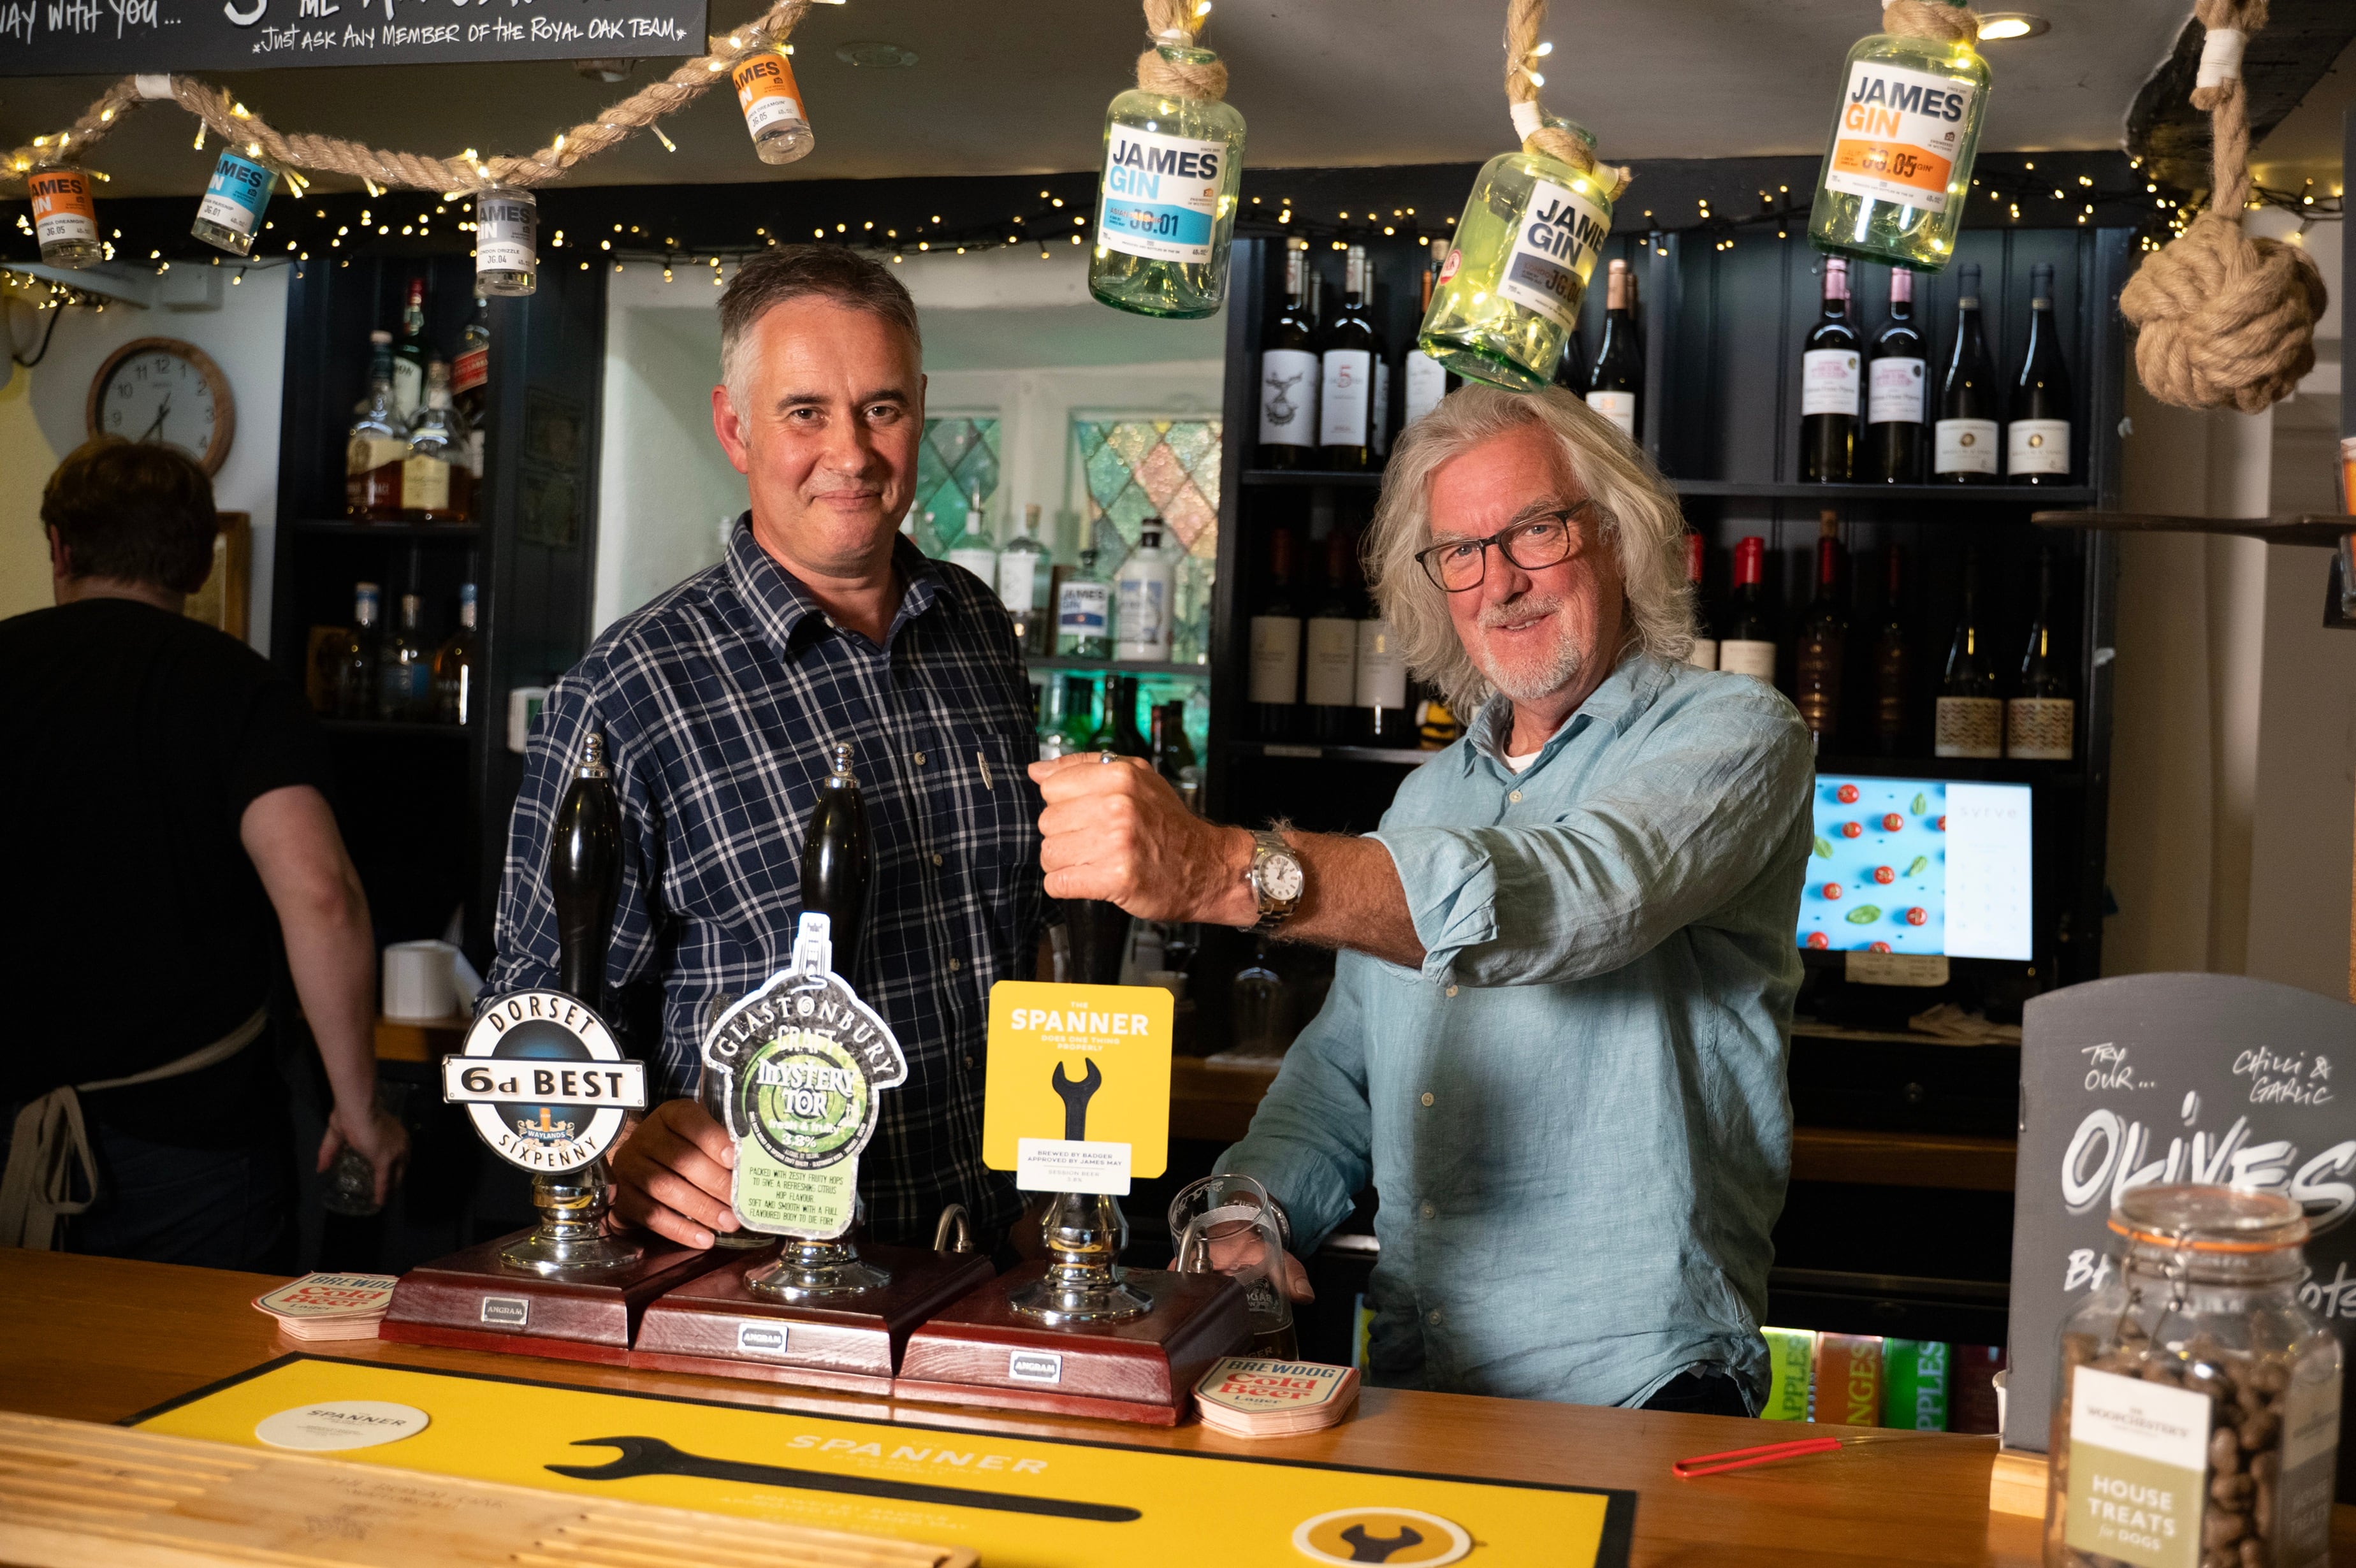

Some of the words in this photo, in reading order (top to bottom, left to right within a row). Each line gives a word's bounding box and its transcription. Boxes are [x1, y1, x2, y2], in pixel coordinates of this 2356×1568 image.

[0, 1, 36, 45] AY
[48, 0, 103, 34] WITH
[302, 31, 337, 51] ASK
[343, 24, 375, 48] ANY
[382, 25, 460, 47] MEMBER
[468, 24, 490, 42] OF
[532, 17, 584, 42] ROYAL
[588, 18, 624, 40] OAK
[735, 62, 780, 92] AMES
[1851, 76, 1964, 123] JAMES
[1845, 102, 1902, 139] GIN
[1113, 140, 1218, 180] JAMES
[31, 179, 84, 198] AMES
[1110, 164, 1160, 200] GIN
[479, 206, 530, 224] AMES
[1110, 207, 1128, 217] ASIAN
[479, 222, 497, 239] IN
[1528, 223, 1583, 267] GIN
[154, 356, 170, 374] 12
[488, 996, 595, 1034] DORSET
[1011, 1008, 1149, 1035] SPANNER
[717, 996, 895, 1075] GLASTONBURY
[777, 1025, 836, 1054] CRAFT
[1057, 1043, 1103, 1051] PROPERLY
[2081, 1042, 2127, 1070] TRY
[461, 1067, 519, 1094] 6d
[534, 1070, 623, 1098] BEST
[757, 1057, 855, 1098] MYSTERY
[782, 1089, 828, 1117] TOR
[527, 1130, 565, 1139] WAYLANDS
[782, 1133, 817, 1148] 3.8%
[498, 1134, 597, 1167] SIXPENNY
[750, 1167, 771, 1177] PACKED
[773, 1170, 787, 1179] WITH
[789, 1172, 806, 1180] ZESTY
[808, 1174, 827, 1183] FRUITY
[829, 1177, 843, 1185] HOPS
[753, 1177, 760, 1186] TO
[762, 1179, 774, 1187] GIVE
[783, 1181, 816, 1192] REFRESHING
[817, 1185, 837, 1194] CITRUS
[776, 1191, 787, 1199] HOP
[748, 1198, 762, 1207] SOFT
[765, 1200, 776, 1209] AND
[778, 1201, 800, 1211] SMOOTH
[824, 1207, 838, 1216] FULL
[749, 1209, 781, 1219] FLAVOURED
[783, 1212, 797, 1221] BODY
[808, 1216, 818, 1224] DIE
[820, 1216, 834, 1225] FOR!
[309, 1276, 398, 1289] BREWDO
[280, 1293, 368, 1307] Beer
[299, 1286, 388, 1300] Cold
[488, 1306, 523, 1315] ANGRAM
[743, 1333, 782, 1344] ANGRAM
[1015, 1361, 1056, 1373] ANGRAM
[1227, 1360, 1336, 1378] BREWDOG
[1227, 1372, 1318, 1390] Cold
[1848, 1341, 1878, 1426] NGES
[1917, 1341, 1945, 1432] PPLES
[1218, 1383, 1311, 1400] Beer
[1234, 1395, 1282, 1404] Lager
[307, 1410, 407, 1426] SPANNER
[786, 1435, 1047, 1474] SPANNER
[2092, 1474, 2173, 1511] HOUSE
[2087, 1497, 2176, 1537] TREATS
[2118, 1529, 2161, 1551] DOGS
